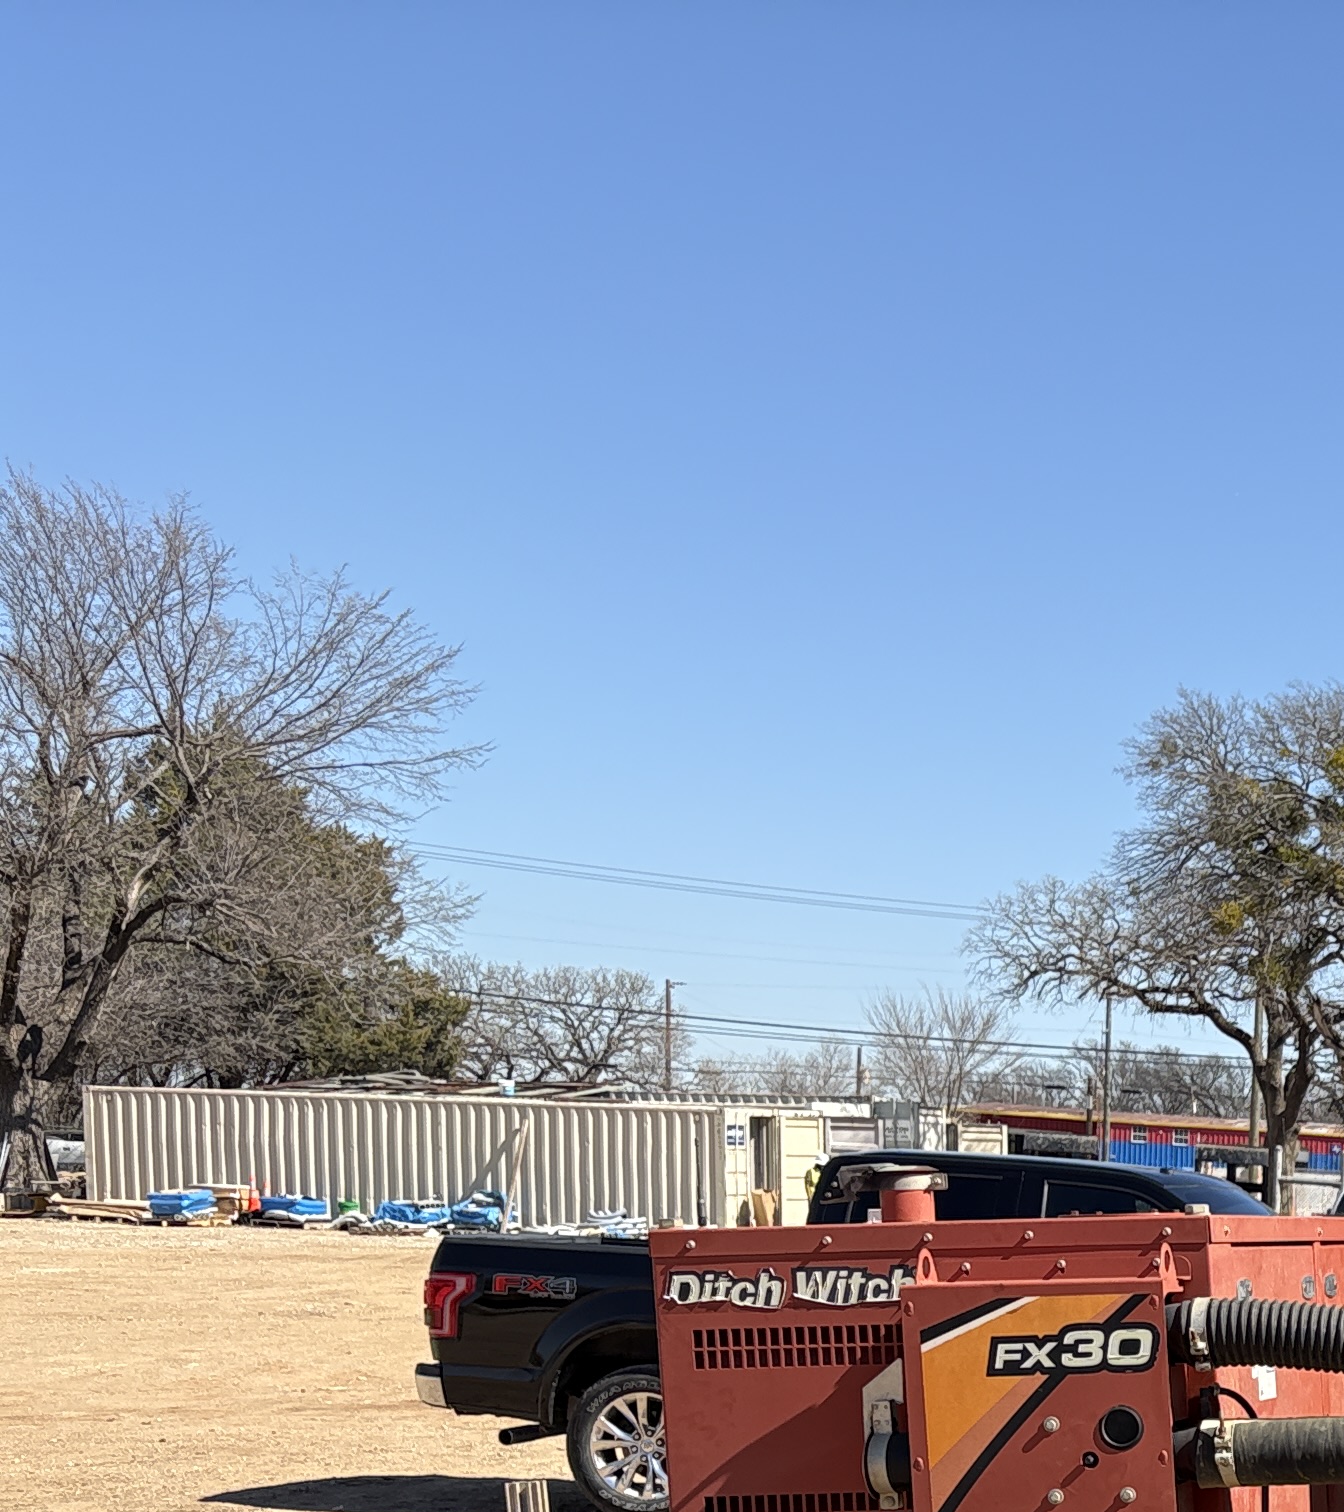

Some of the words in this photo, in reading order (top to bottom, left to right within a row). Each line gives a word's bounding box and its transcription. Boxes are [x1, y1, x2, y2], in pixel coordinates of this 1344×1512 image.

[493, 1274, 577, 1297] FX4
[669, 1271, 784, 1309] Ditch
[995, 1328, 1154, 1370] FX30
